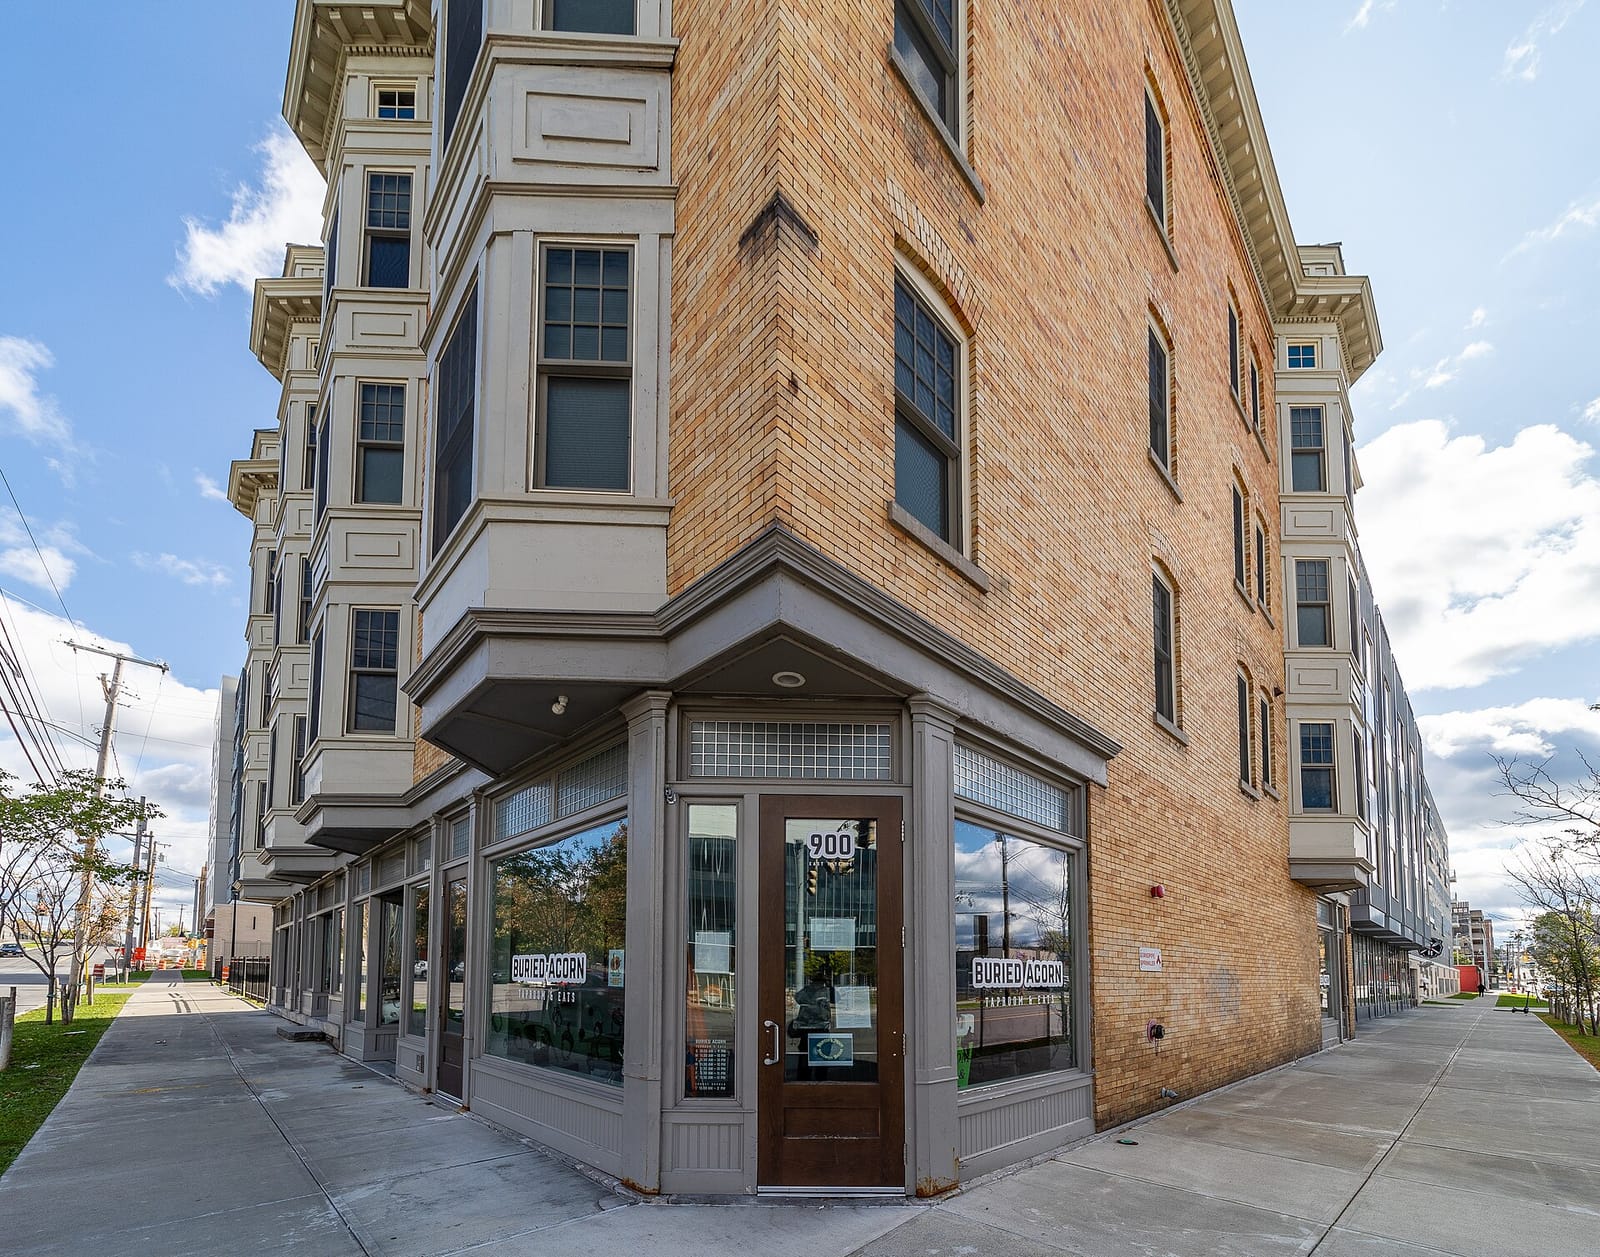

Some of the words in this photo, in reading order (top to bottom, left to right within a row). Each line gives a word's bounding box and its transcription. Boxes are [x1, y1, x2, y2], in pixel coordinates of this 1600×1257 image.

[810, 833, 851, 855] 900
[513, 957, 545, 979] BURIED
[548, 956, 585, 979] ACORN
[975, 961, 1021, 984] BURIED
[1026, 963, 1061, 984] ACORN
[557, 991, 576, 1003] EATS
[985, 996, 1024, 1008] TAPROOM
[1037, 994, 1055, 1005] EATS
